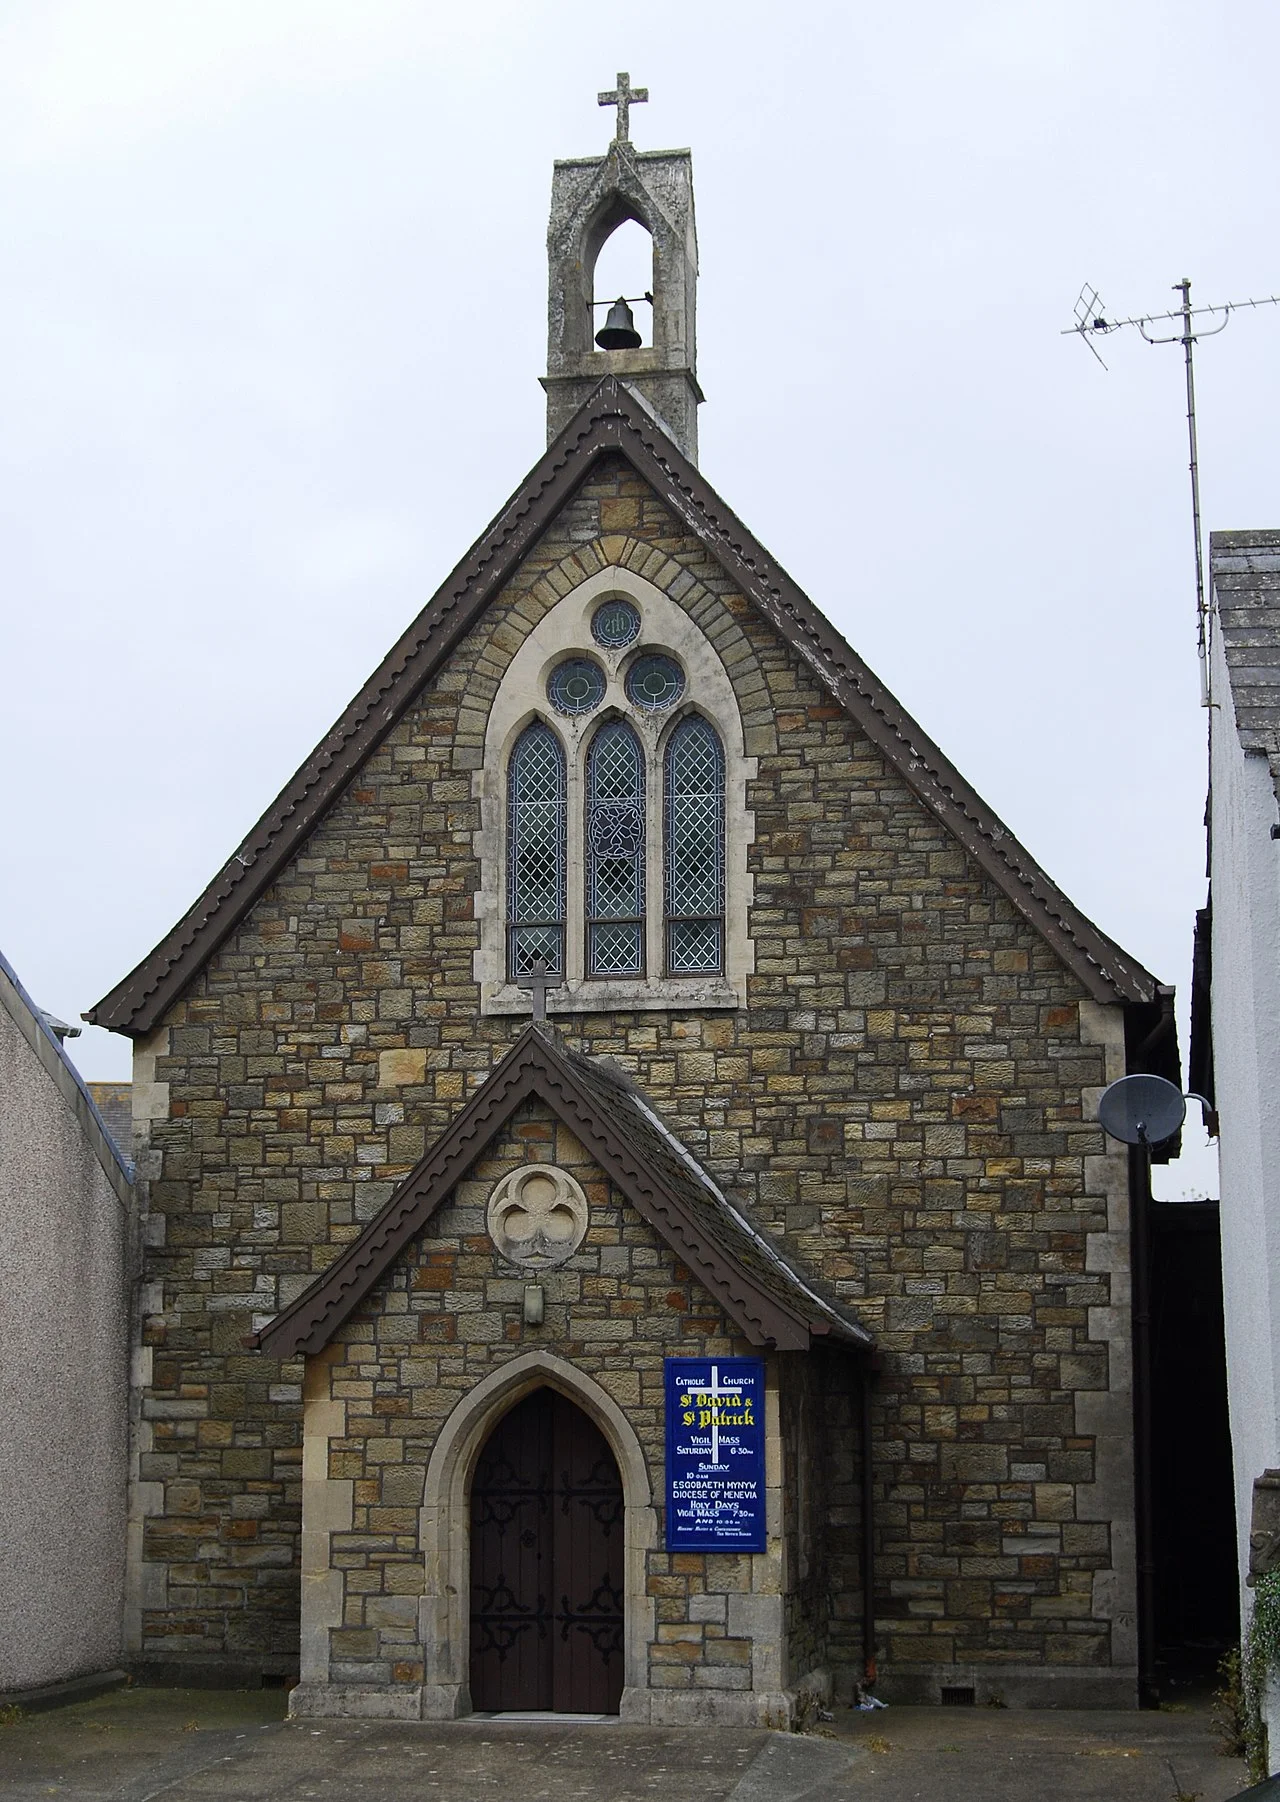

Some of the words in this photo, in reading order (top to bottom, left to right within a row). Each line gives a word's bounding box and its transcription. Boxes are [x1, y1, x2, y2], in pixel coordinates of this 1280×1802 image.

[675, 1376, 705, 1386] CATHOLIC
[723, 1376, 754, 1385] CHURCH
[695, 1393, 742, 1407] David
[745, 1398, 753, 1407] &
[698, 1408, 755, 1429] Patrick
[718, 1435, 740, 1444] MASS
[676, 1445, 713, 1455] SATURDAY
[698, 1462, 730, 1470] SUNDAY
[672, 1481, 725, 1489] ESGOBAETH
[726, 1481, 757, 1489] MYNYW
[672, 1490, 708, 1499] DIOCESE
[710, 1490, 721, 1499] OF
[723, 1490, 757, 1499] MENEVIA
[690, 1500, 711, 1508] HOLY
[714, 1500, 740, 1509] DAYS
[696, 1509, 720, 1517] MASS
